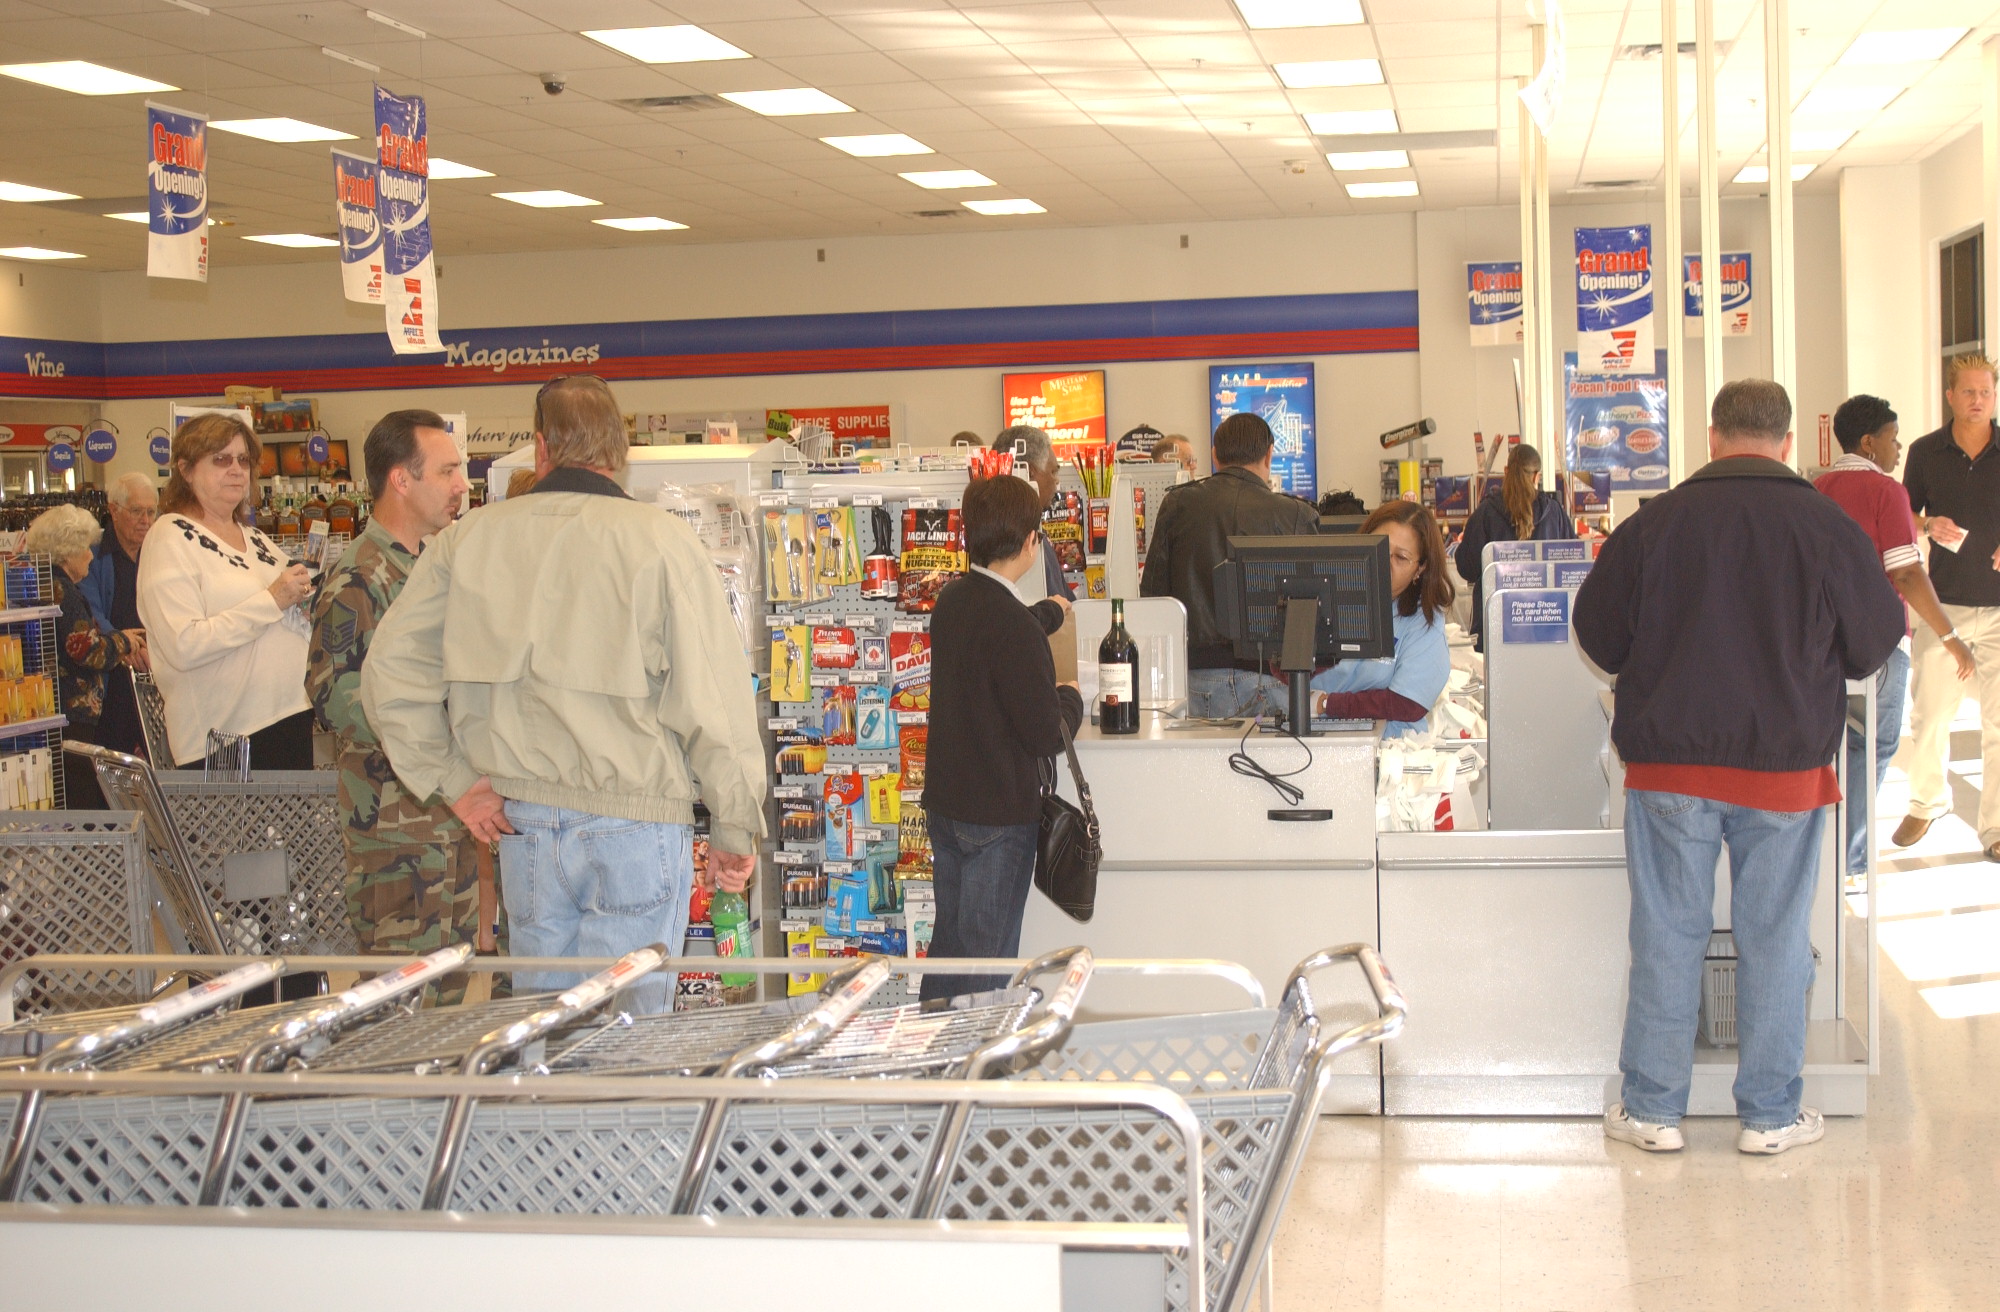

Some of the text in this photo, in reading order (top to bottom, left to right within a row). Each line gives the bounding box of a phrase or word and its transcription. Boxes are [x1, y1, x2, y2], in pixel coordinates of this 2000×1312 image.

[153, 122, 205, 171] Grand
[380, 123, 428, 177] Grand
[155, 166, 203, 199] Opening!
[336, 165, 375, 208] Grand
[380, 169, 423, 207] Opening!
[339, 200, 374, 232] Opening!
[1579, 246, 1648, 273] Grand
[1579, 271, 1643, 291] Opening!
[445, 339, 600, 372] Magazines
[25, 352, 65, 377] Wine
[1570, 381, 1603, 394] Pecan
[1606, 380, 1631, 392] Food
[1010, 395, 1047, 406] Use the
[1010, 405, 1056, 416] card that
[768, 417, 789, 433] Bulk
[791, 416, 831, 431] OFFICE
[1011, 415, 1056, 428] offers
[1044, 425, 1089, 439] more!
[907, 531, 955, 541] JACK LINK'S
[905, 560, 952, 569] NUGGETS
[896, 652, 931, 672] DAVI
[899, 676, 931, 689] ORIGINA
[862, 937, 882, 945] Kodak
[679, 983, 706, 995] X2
